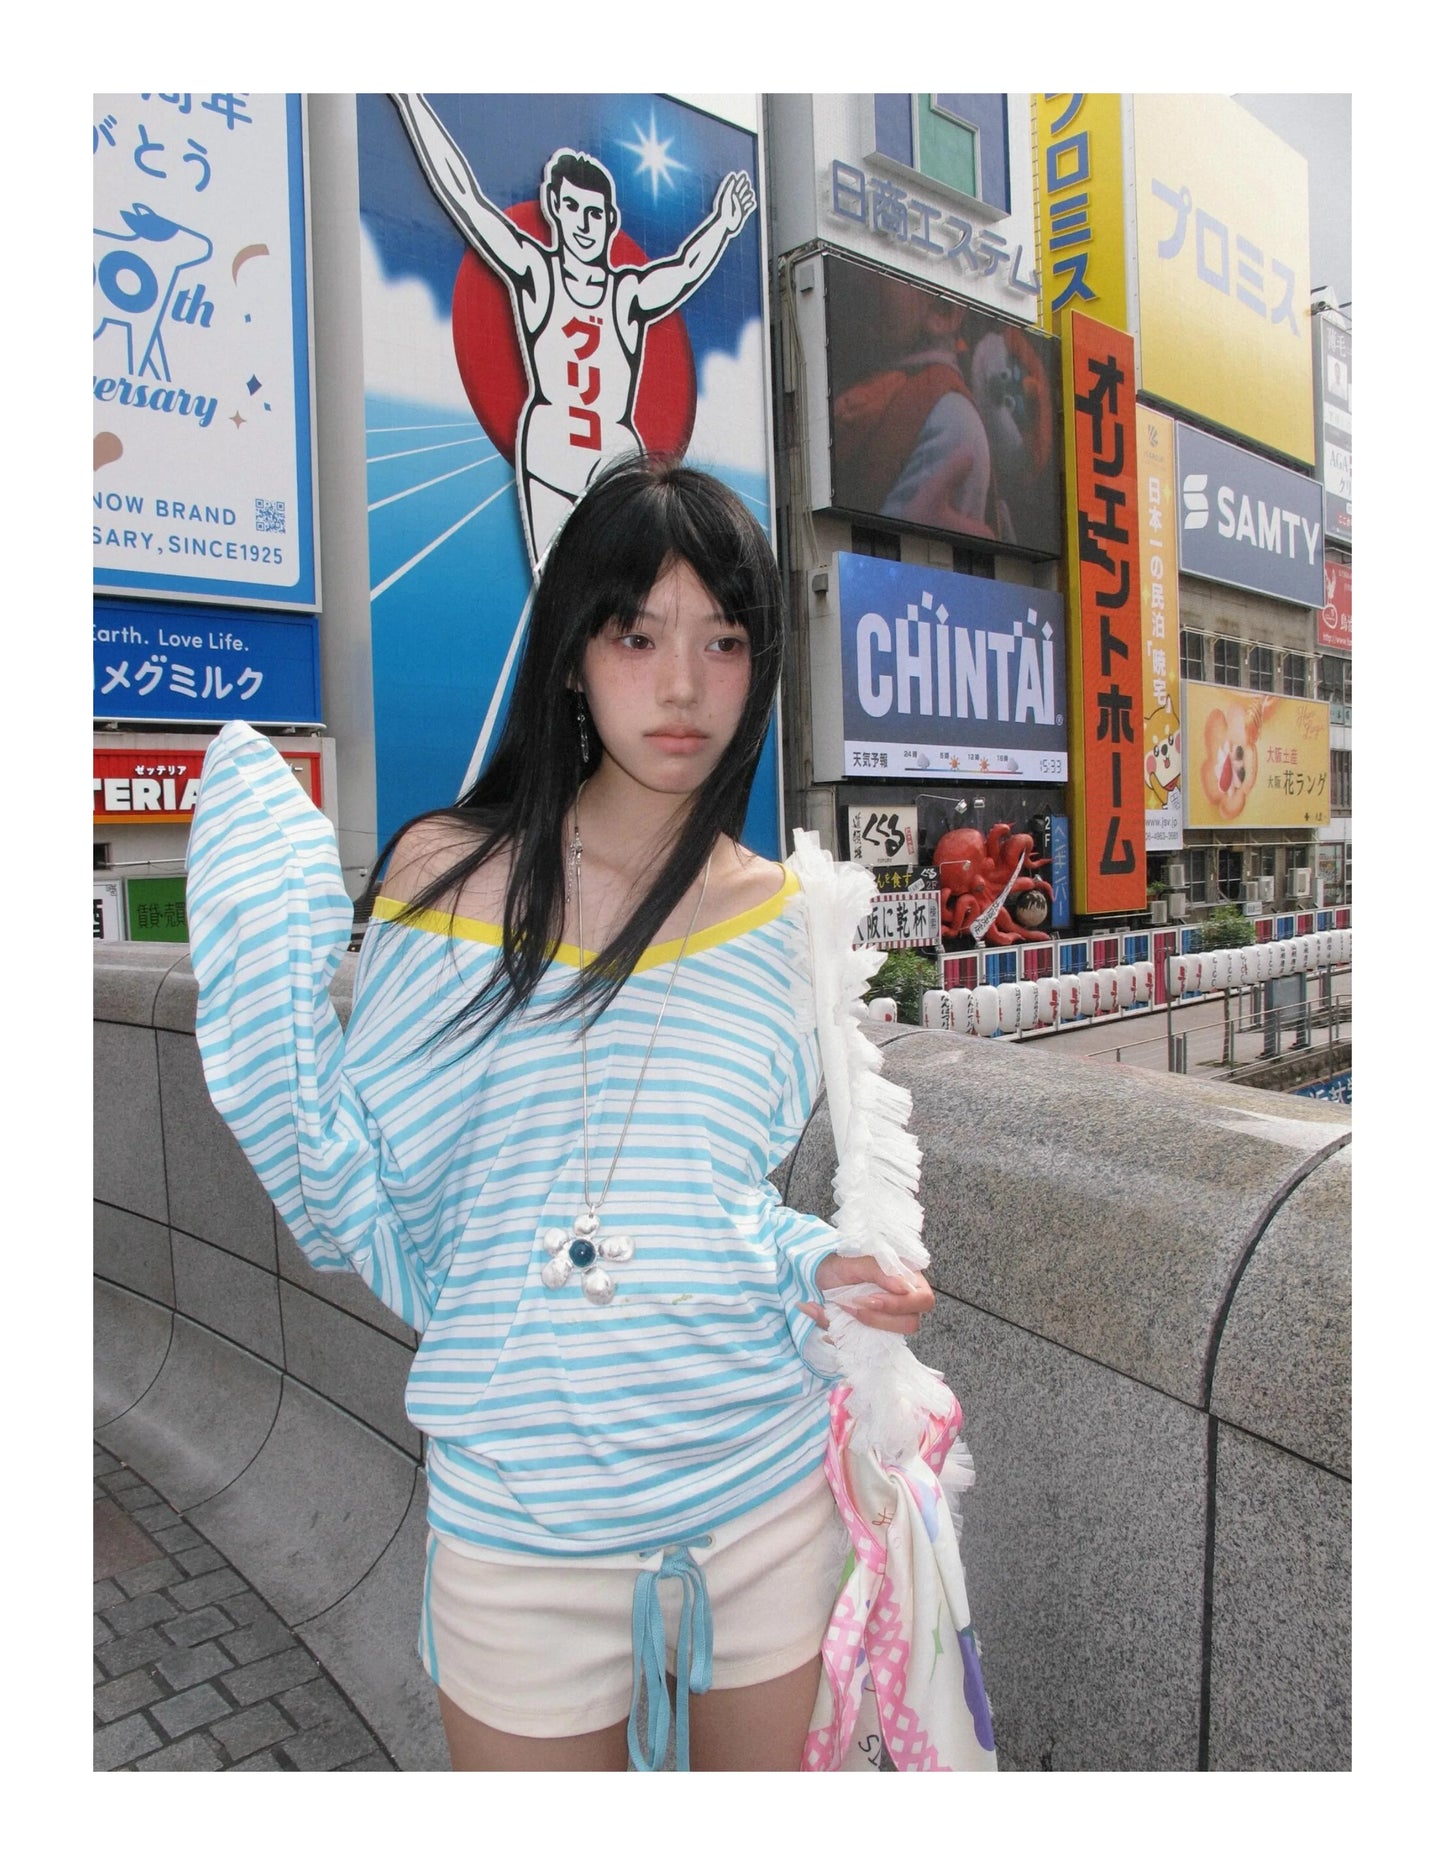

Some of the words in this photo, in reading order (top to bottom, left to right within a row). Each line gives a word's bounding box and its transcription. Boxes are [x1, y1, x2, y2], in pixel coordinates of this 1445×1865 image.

[832, 160, 1040, 296] 日商エステム
[1151, 178, 1300, 338] プロミス
[93, 374, 218, 427] ersary
[561, 315, 603, 451] グリコ
[156, 500, 237, 527] BRAND
[1217, 485, 1321, 565] SAMTY
[159, 629, 203, 649] Love
[209, 632, 249, 652] Life.
[1074, 354, 1136, 876] オリエントホーム
[135, 765, 187, 776] ゼッテリア
[853, 750, 888, 768] 天気予報
[862, 813, 906, 857] くくる
